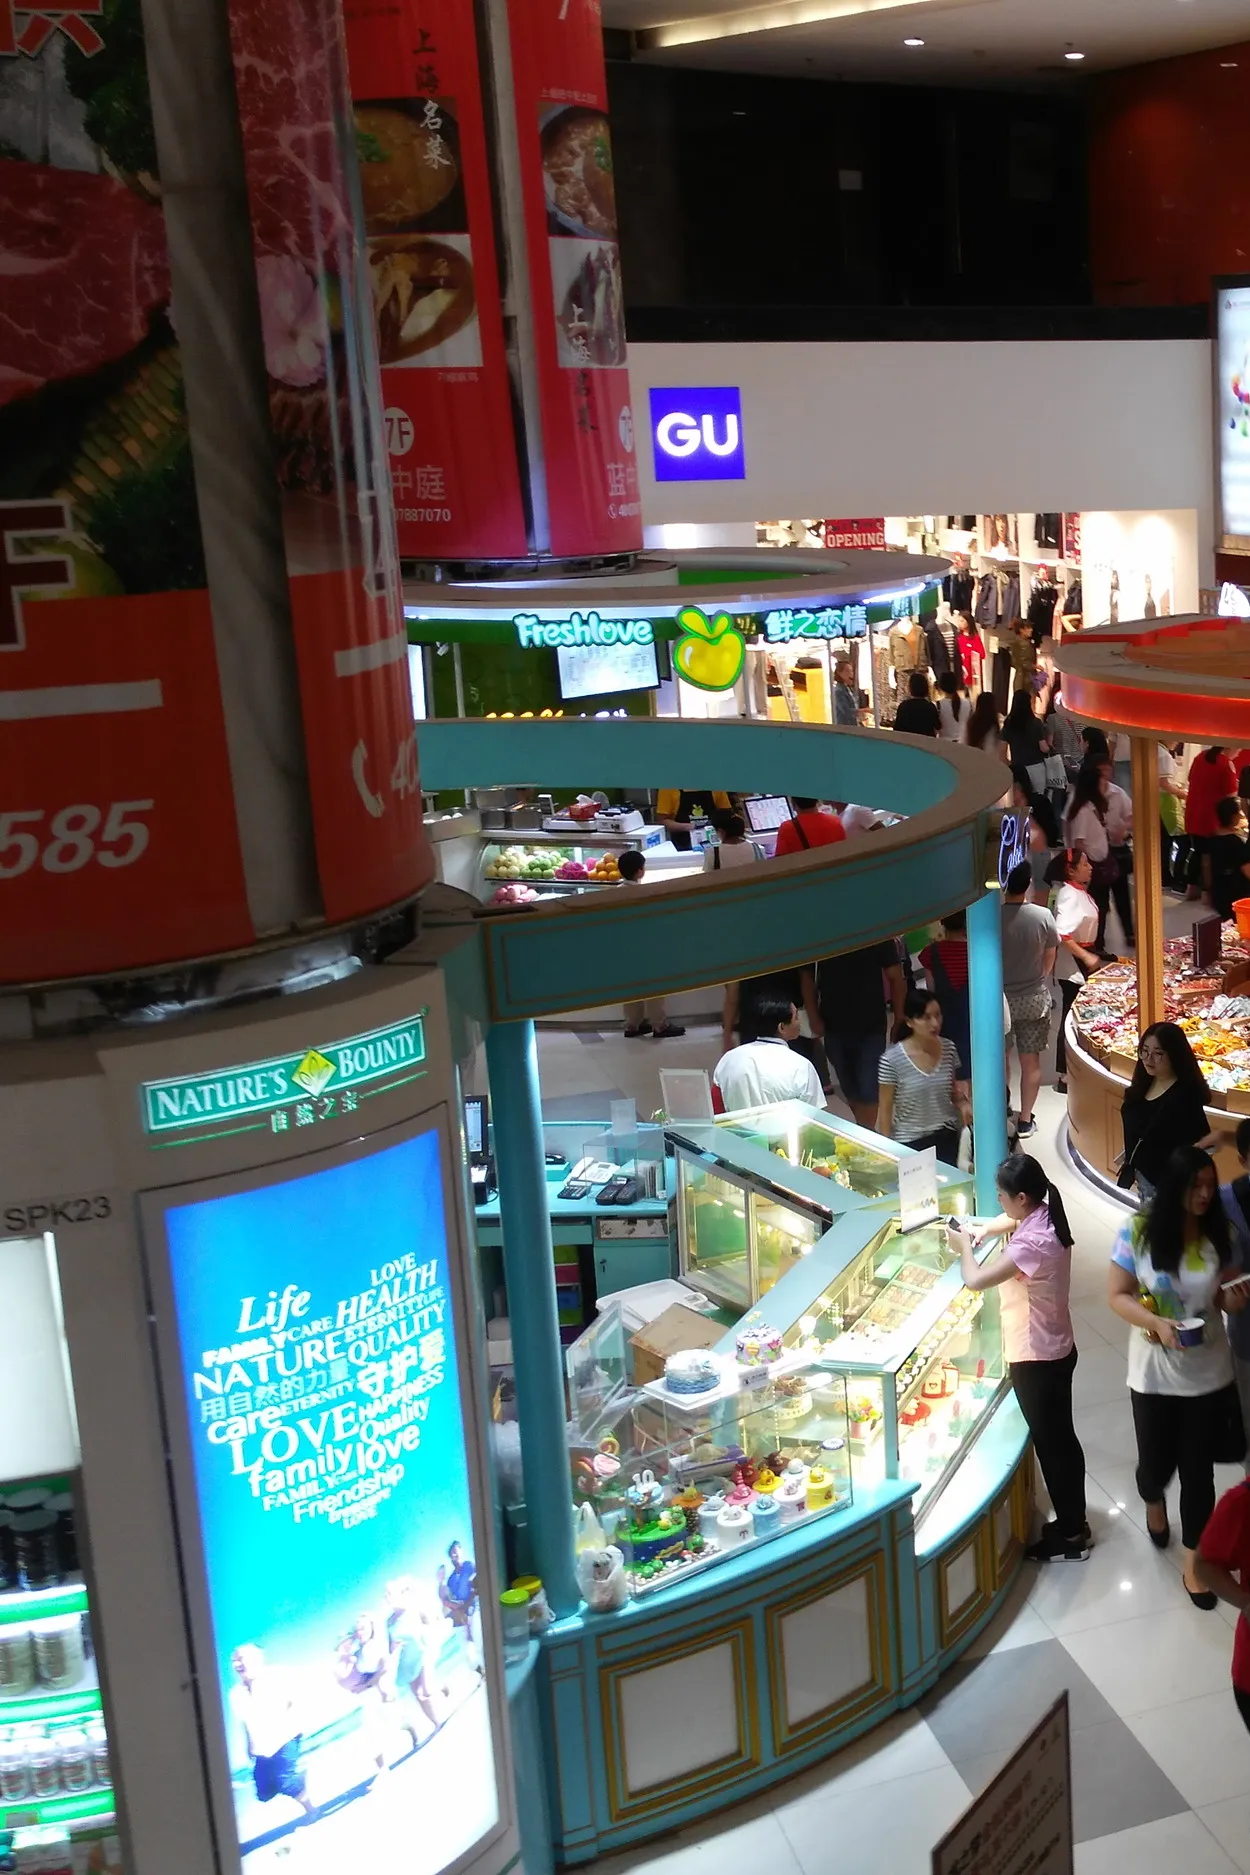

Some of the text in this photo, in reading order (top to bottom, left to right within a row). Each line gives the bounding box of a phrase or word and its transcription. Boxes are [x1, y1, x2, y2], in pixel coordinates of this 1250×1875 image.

[412, 28, 451, 170] 上海名菜
[656, 411, 739, 457] GU
[827, 532, 885, 548] OPENING
[513, 611, 655, 649] Freshlove
[765, 604, 868, 643] 鲜之恋情
[0, 799, 155, 879] 585
[156, 1029, 417, 1119] NATURE'S BOUNTY
[3, 1195, 113, 1232] SPK23
[335, 1259, 439, 1329] HEALTH
[370, 1251, 417, 1284] LOVE
[235, 1283, 312, 1334] Life
[344, 1296, 425, 1342] ETERNITY
[347, 1300, 446, 1366] QUALITY
[193, 1331, 346, 1400] NATURE
[201, 1316, 335, 1369] FAMILY CARE
[199, 1359, 351, 1424] 用自然的力量
[206, 1378, 357, 1445] care ETERNITY
[358, 1365, 446, 1422] HAPPINESS
[360, 1395, 432, 1445] Quality
[230, 1401, 361, 1477] LOVE
[249, 1424, 422, 1498] family love
[262, 1475, 335, 1512] FAMILY
[292, 1463, 406, 1524] Friendship
